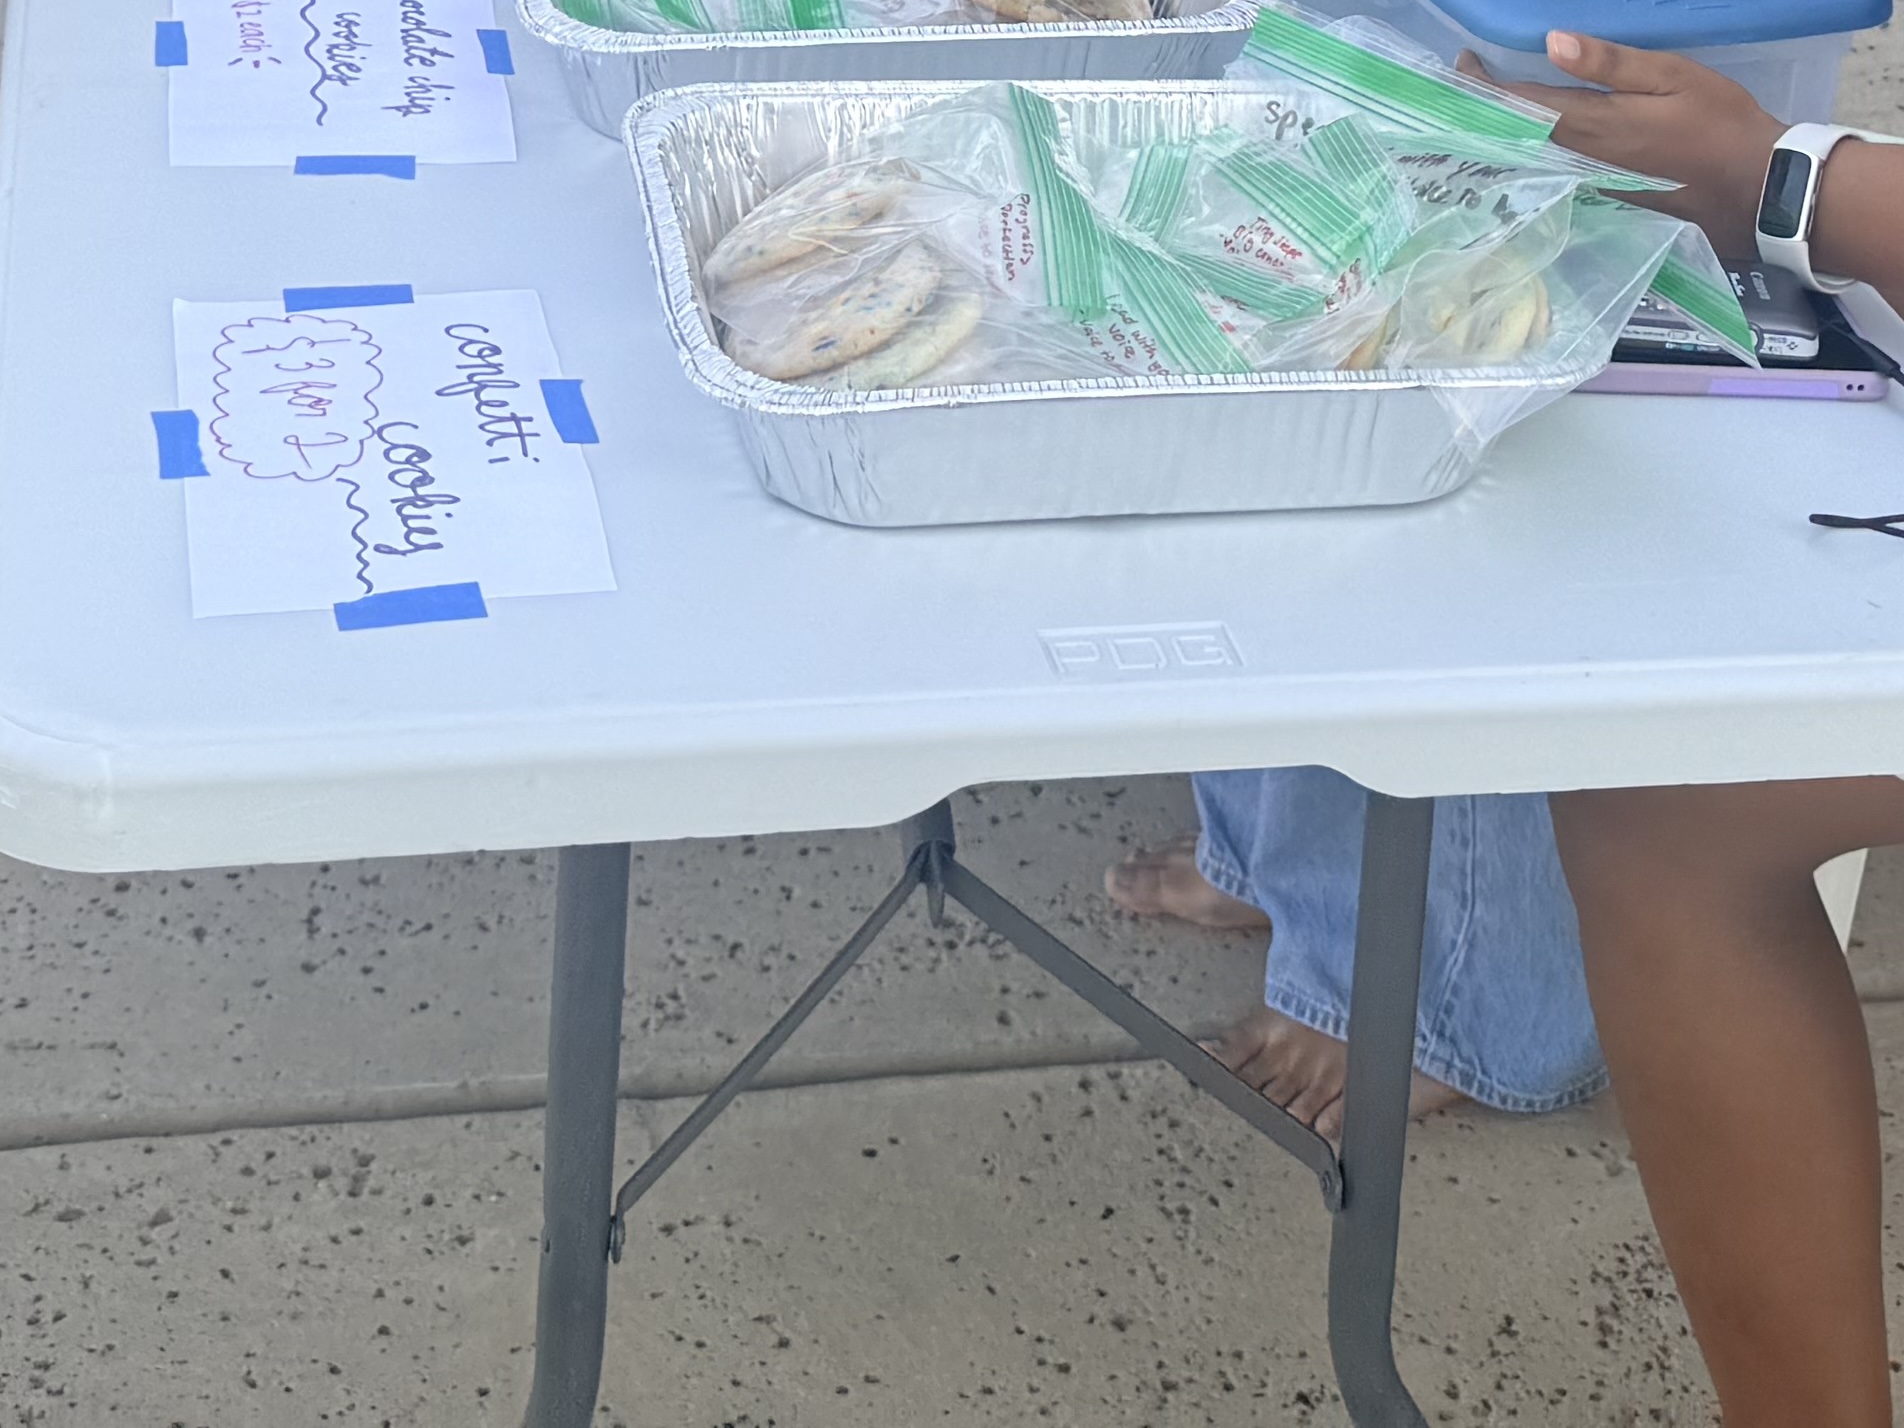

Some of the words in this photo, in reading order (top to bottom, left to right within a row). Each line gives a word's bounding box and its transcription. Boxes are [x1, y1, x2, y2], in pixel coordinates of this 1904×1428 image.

[239, 21, 273, 53] each
[322, 10, 373, 87] cookies
[381, 72, 454, 119] chip
[1249, 216, 1276, 245] Tiny
[1131, 325, 1158, 362] with
[258, 381, 338, 417] for
[435, 321, 540, 465] confetti
[1054, 634, 1234, 674] PDG
